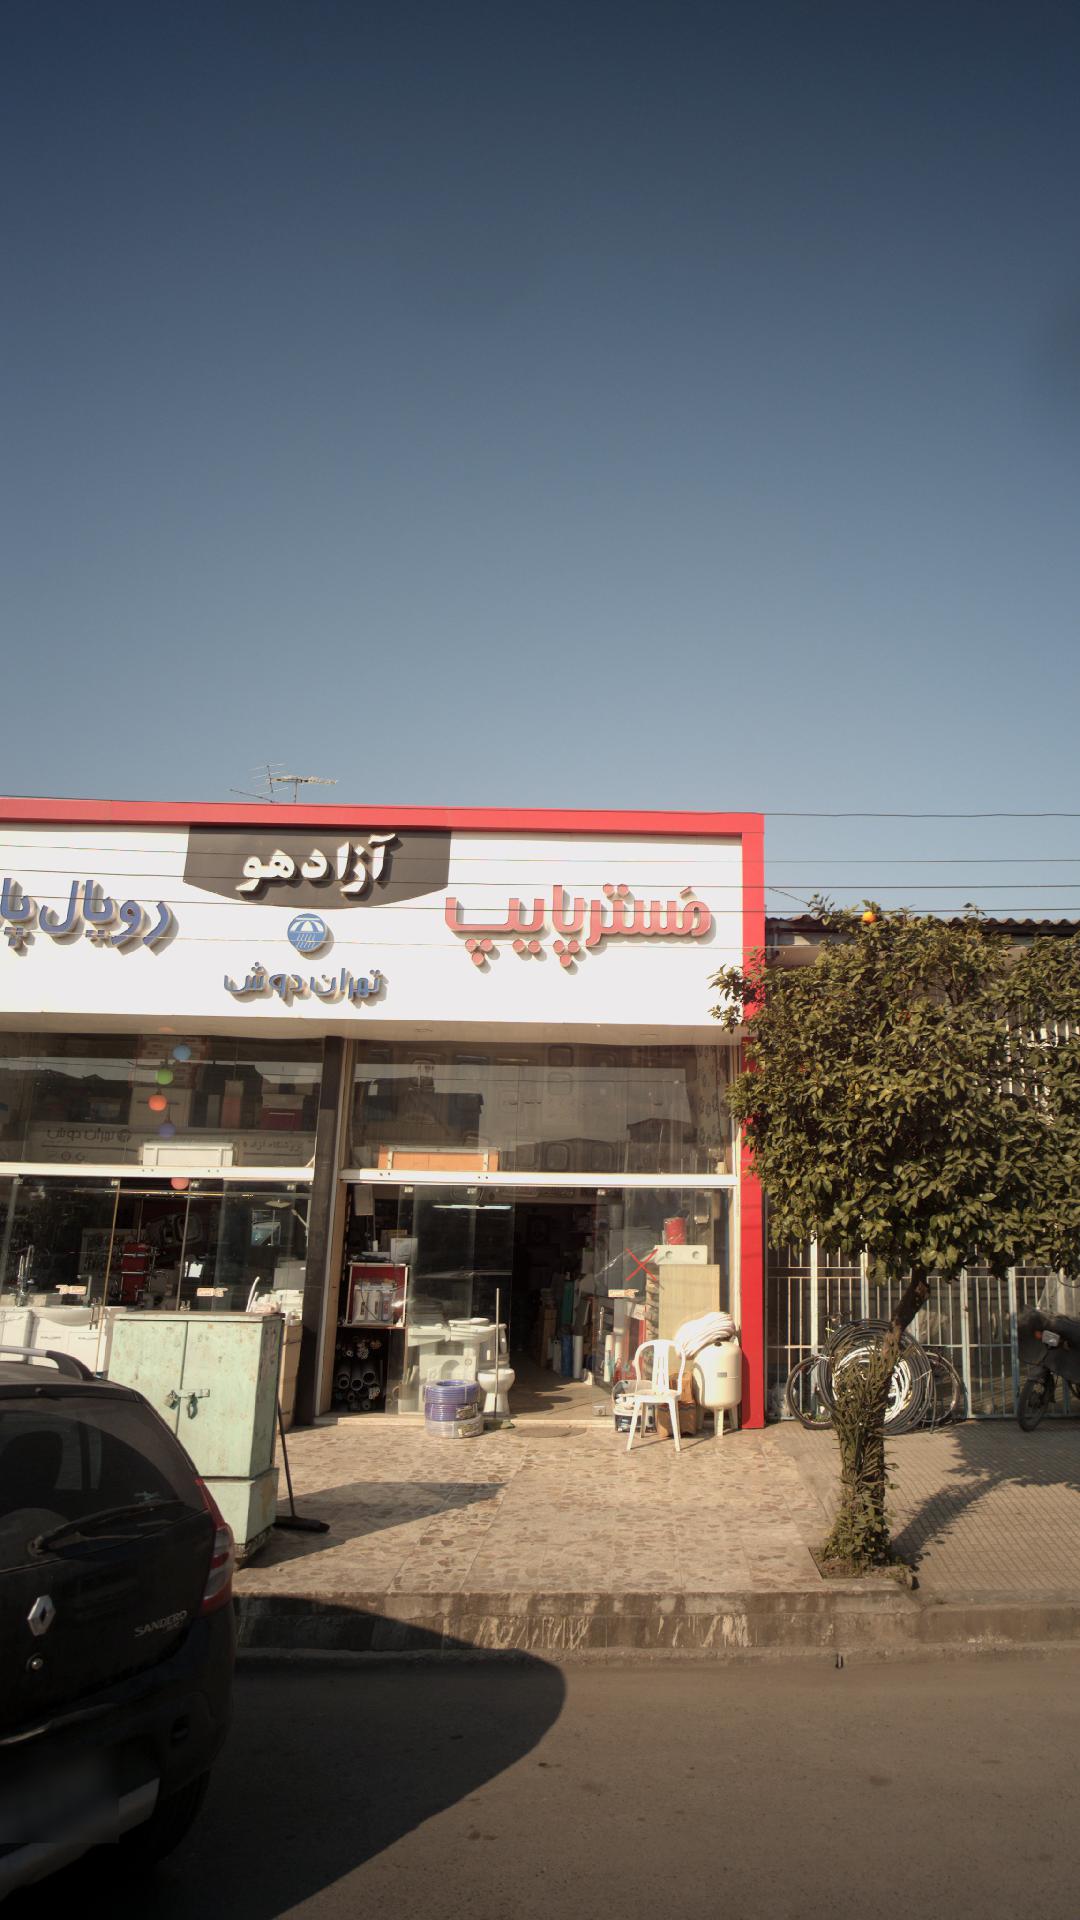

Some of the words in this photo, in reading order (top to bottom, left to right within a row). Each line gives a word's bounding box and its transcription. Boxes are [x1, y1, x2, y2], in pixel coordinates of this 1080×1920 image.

[39, 880, 170, 946] رویال
[445, 885, 585, 967] پایپ
[224, 962, 303, 998] دوش
[310, 968, 381, 1000] تهران
[134, 1610, 188, 1637] SANDERO
